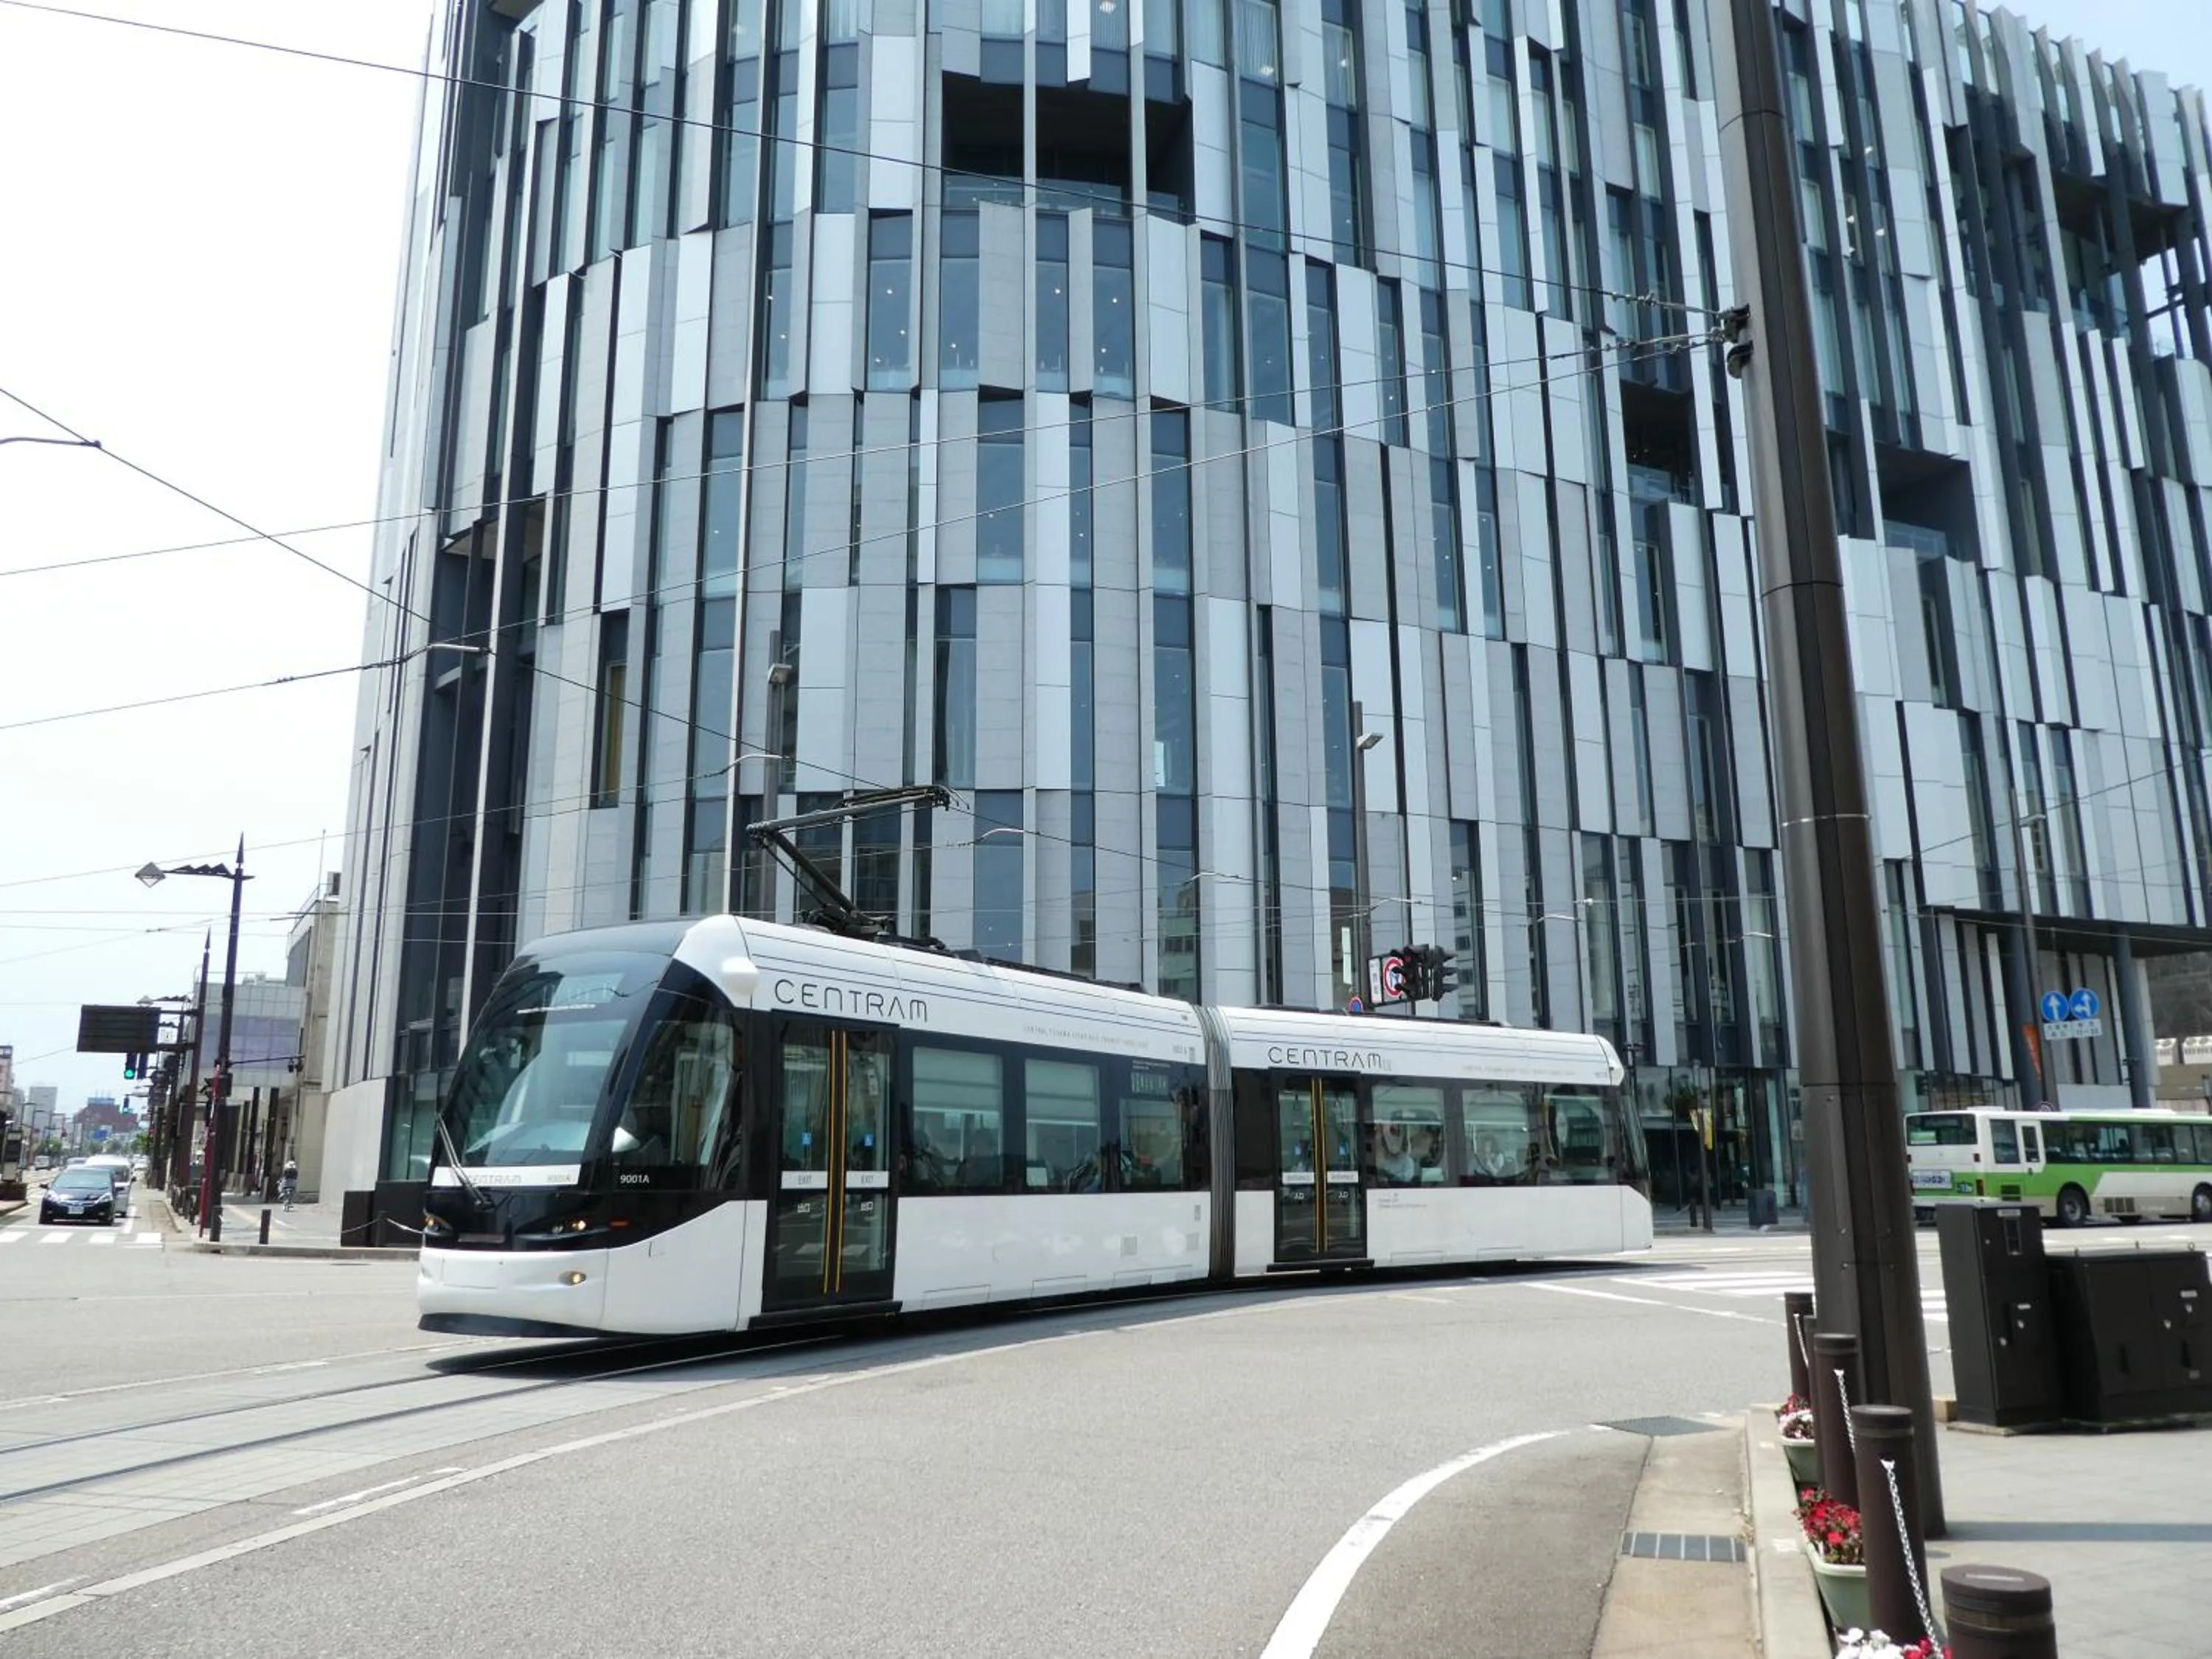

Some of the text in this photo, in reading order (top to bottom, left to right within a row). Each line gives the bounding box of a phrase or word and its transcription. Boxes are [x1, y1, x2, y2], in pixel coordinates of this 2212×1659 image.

[774, 978, 928, 1023] CENTRAM
[1267, 1046, 1382, 1069] CENTRAM
[620, 1175, 650, 1184] 9001A
